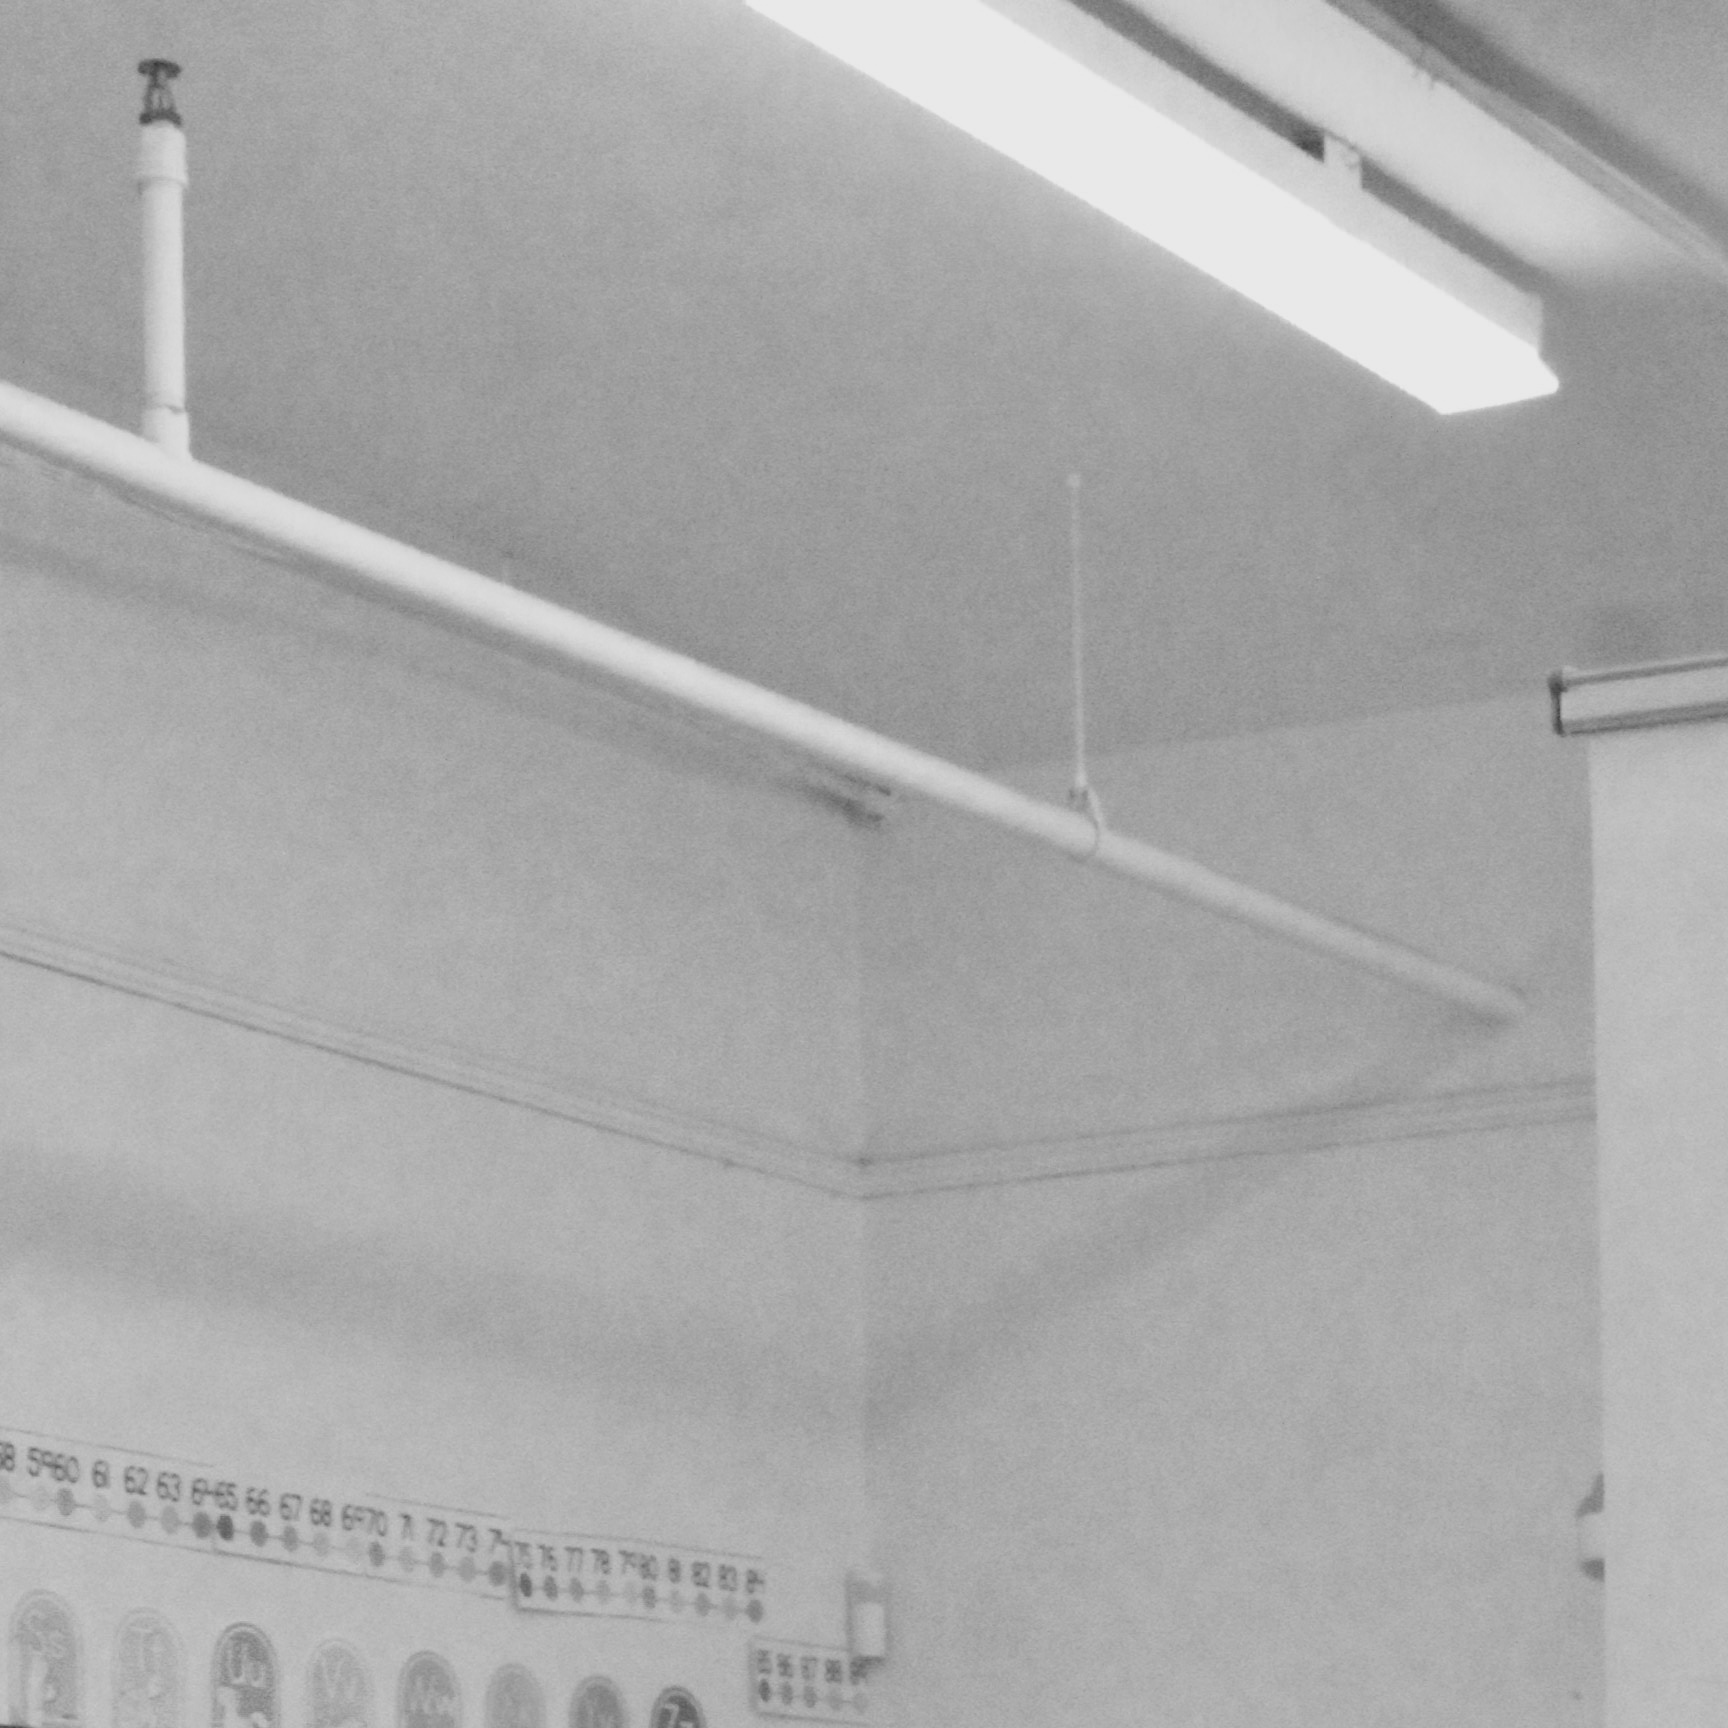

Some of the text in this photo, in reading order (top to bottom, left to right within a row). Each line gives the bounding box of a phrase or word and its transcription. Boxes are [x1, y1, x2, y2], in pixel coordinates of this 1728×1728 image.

[53, 1453, 80, 1484] 60
[124, 1466, 149, 1495] 62
[157, 1472, 182, 1502] 63
[215, 1481, 238, 1511] 65
[246, 1486, 271, 1517] 66
[279, 1493, 302, 1520] 67
[309, 1498, 333, 1527] 68
[364, 1508, 388, 1537] 70
[427, 1518, 449, 1547] 72
[455, 1523, 479, 1552] 73
[223, 1632, 268, 1684] Uu
